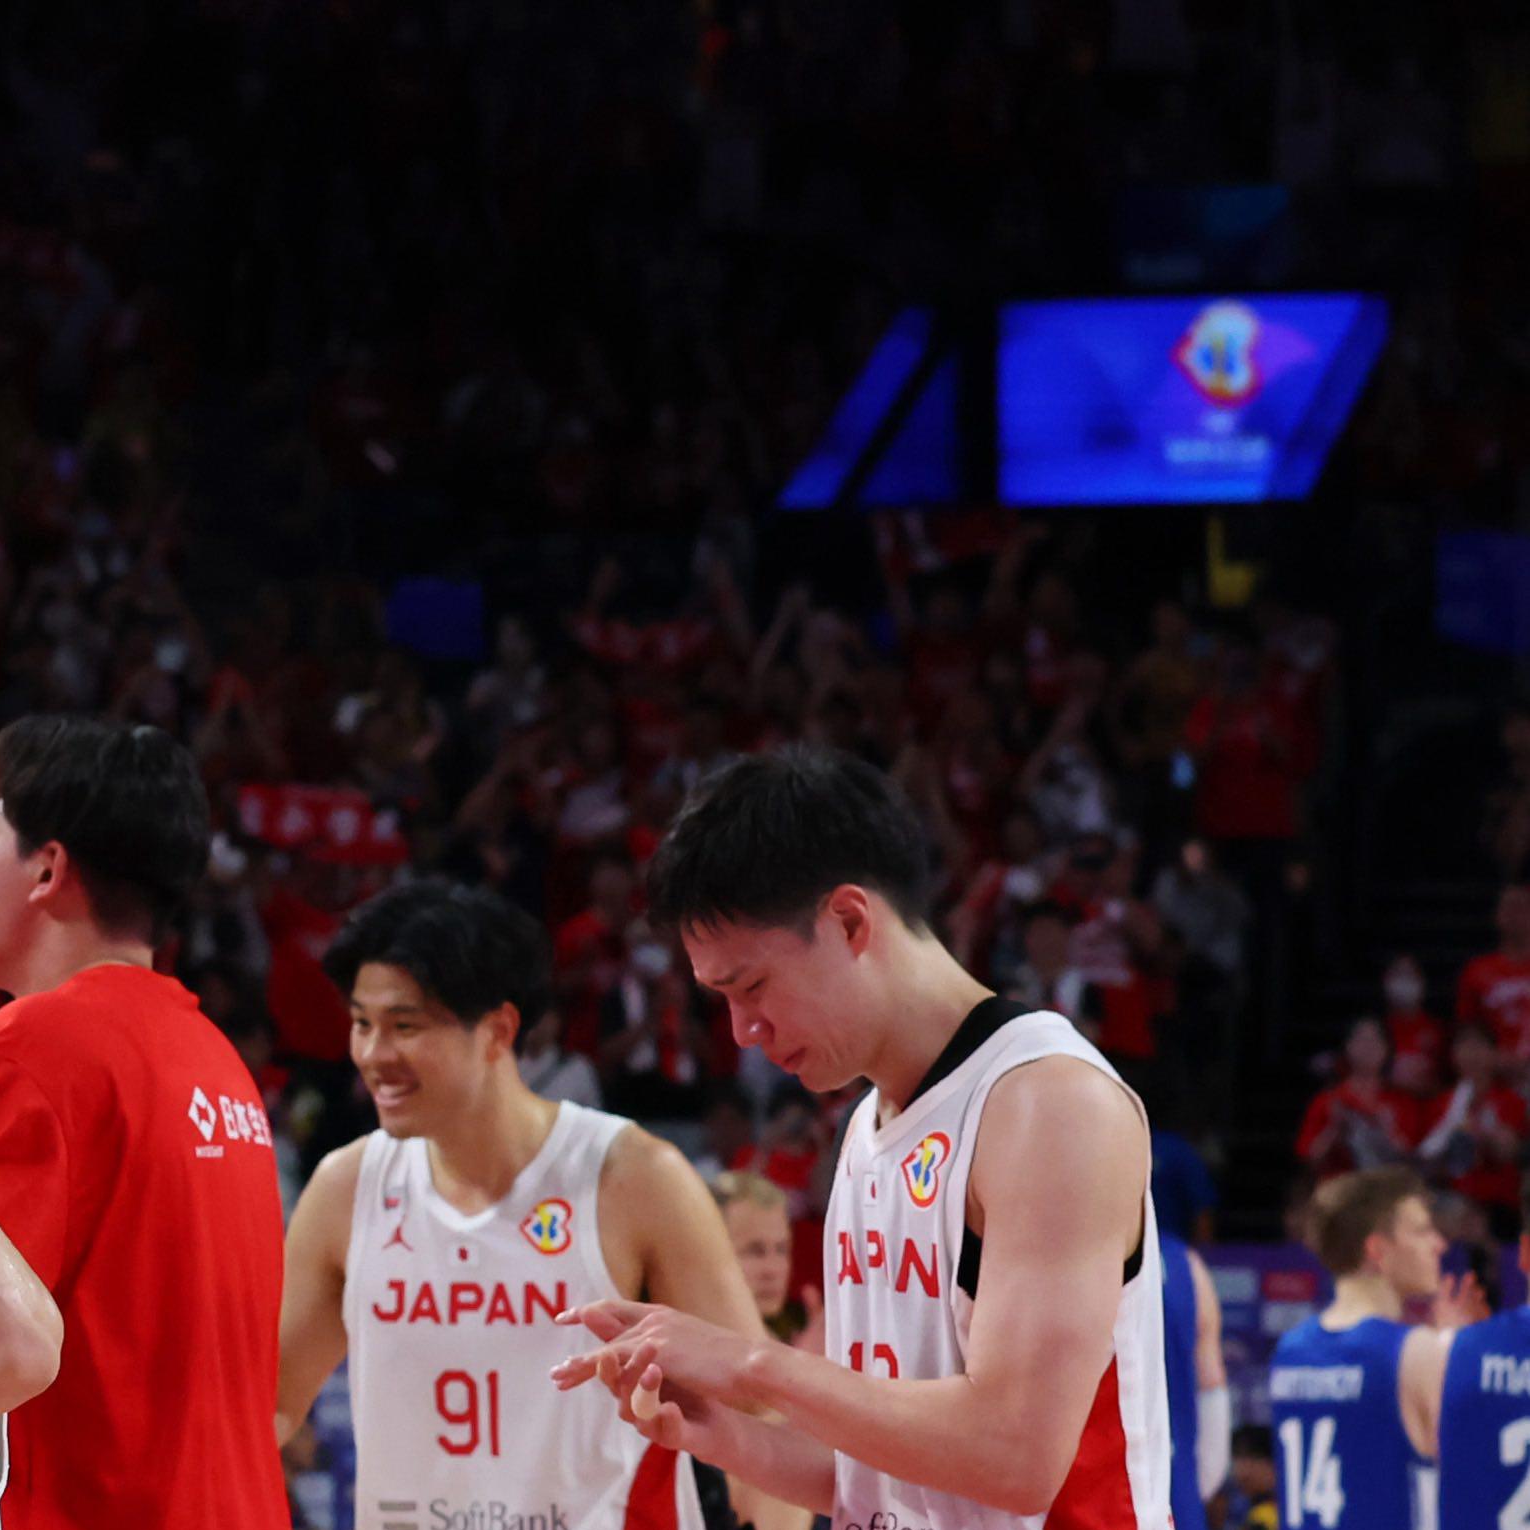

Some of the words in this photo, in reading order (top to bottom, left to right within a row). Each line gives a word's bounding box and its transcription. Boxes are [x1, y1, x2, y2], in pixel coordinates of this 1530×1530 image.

[371, 1278, 567, 1326] JAPAN
[433, 1368, 501, 1458] 91
[1278, 1415, 1346, 1530] 14
